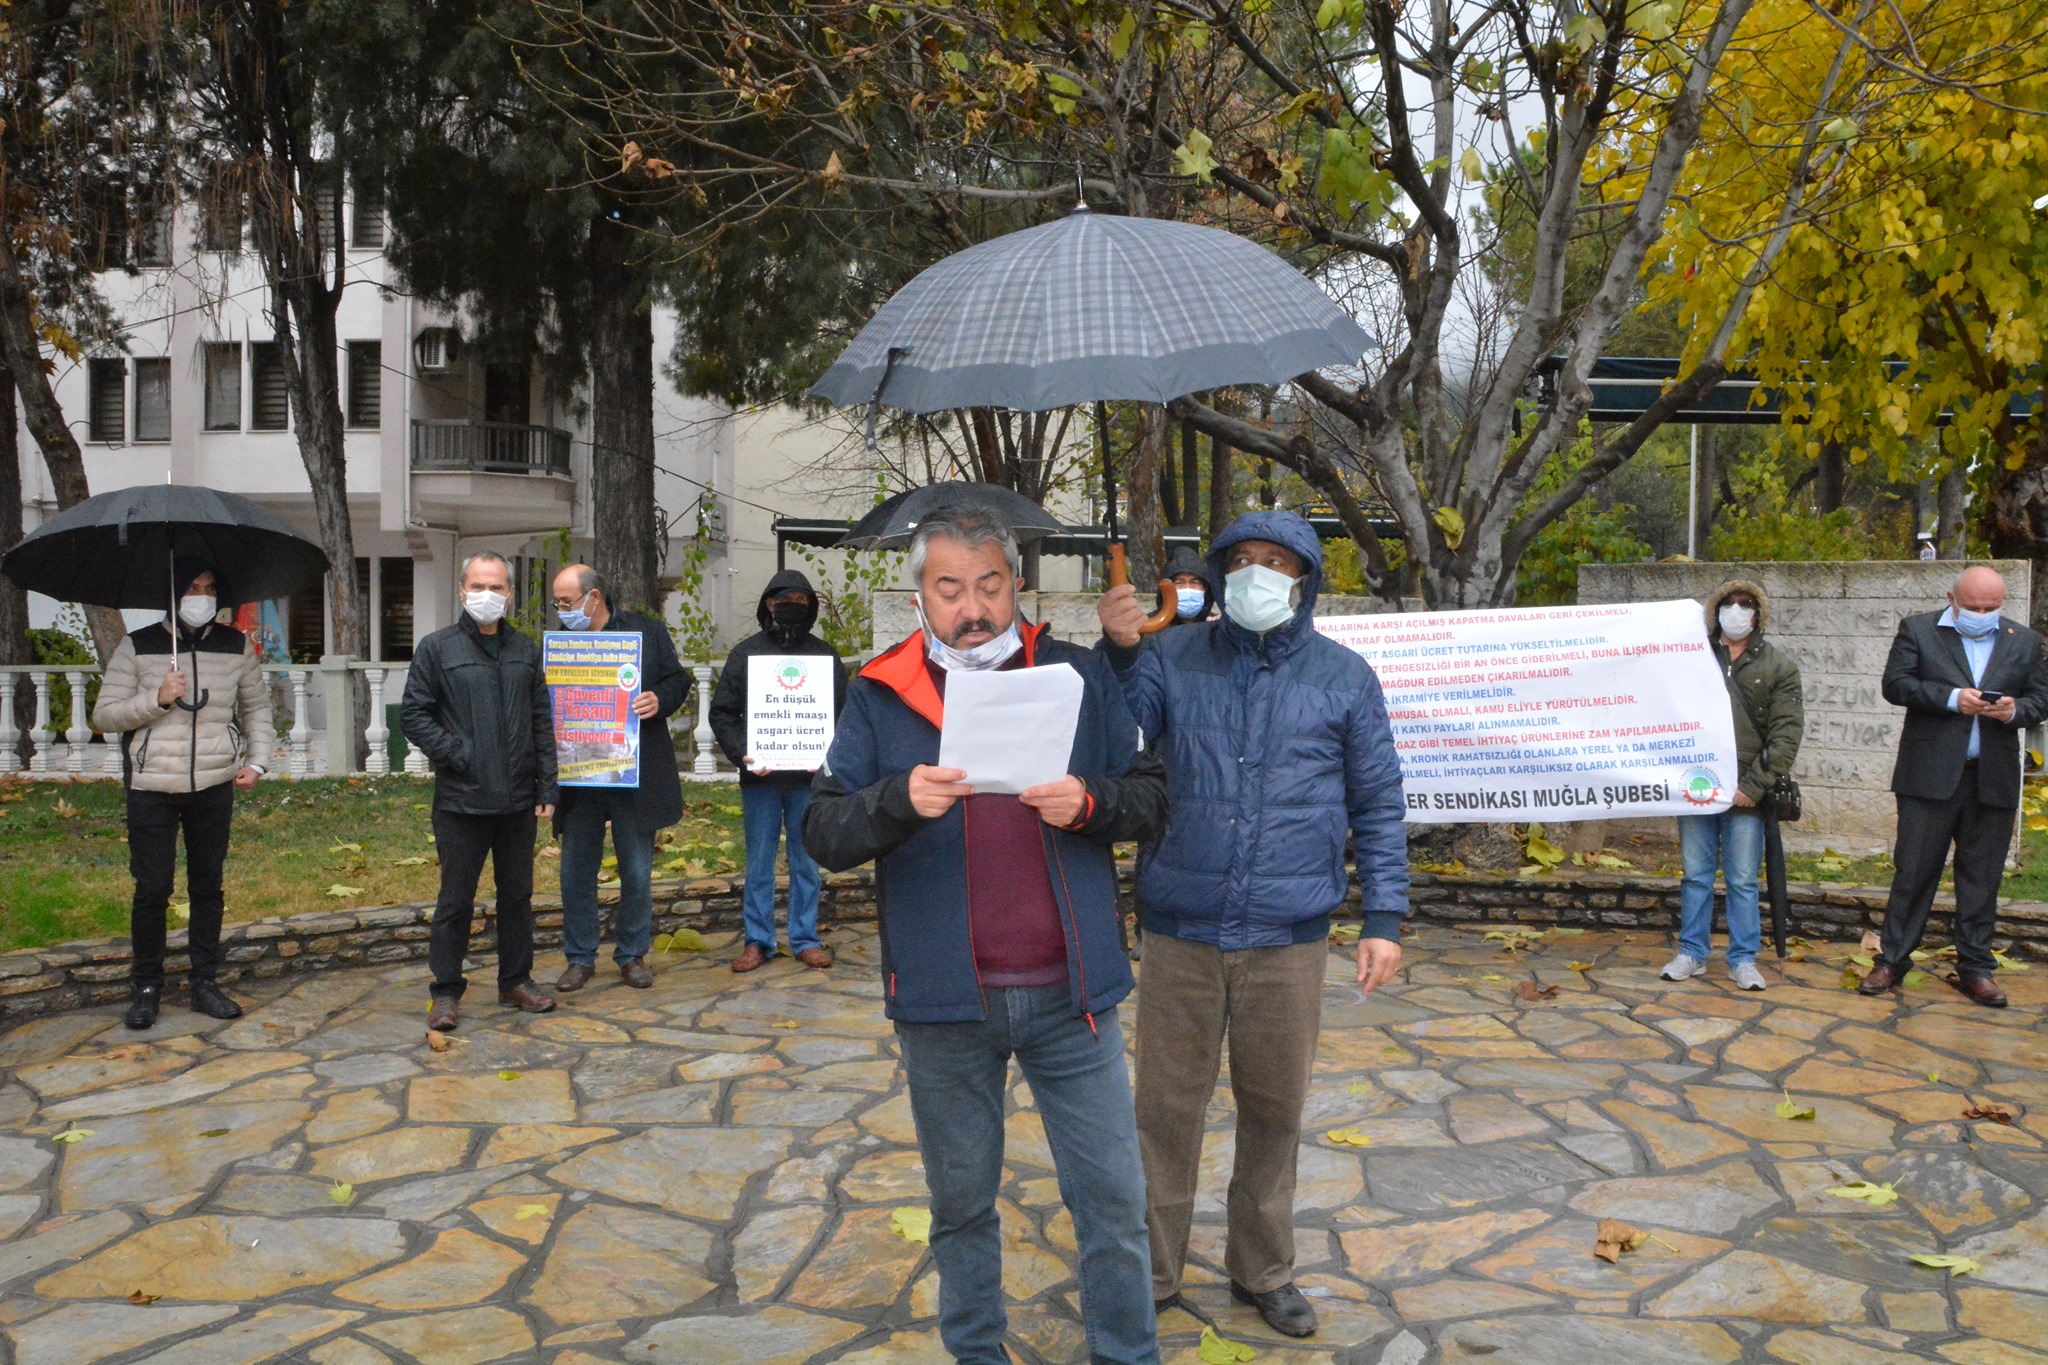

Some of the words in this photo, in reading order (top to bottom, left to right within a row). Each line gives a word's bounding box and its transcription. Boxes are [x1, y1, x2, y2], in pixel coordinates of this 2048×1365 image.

[1373, 621, 1402, 630] KARŞI
[1406, 618, 1446, 629] AÇILMIŞ
[1448, 616, 1495, 625] KAPATMA
[1498, 613, 1546, 623] DAVALARI
[1549, 611, 1572, 619] GERİ
[1575, 608, 1632, 619] ÇEKİLMELİ,
[1350, 636, 1381, 645] TARAF
[1384, 631, 1455, 644] OLMAMALIDIR.
[1381, 647, 1418, 659] ASGARİ
[1420, 646, 1454, 657] ÜCRET
[1456, 643, 1507, 654] TUTARINA
[1509, 636, 1609, 651] YÜKSELTİLMELİDİR.
[1382, 661, 1451, 674] DENGESİZLİĞİ
[1454, 659, 1471, 669] BİR
[1474, 659, 1488, 667] AN
[1491, 657, 1518, 666] ÖNCE
[1591, 648, 1620, 659] BUNA
[1622, 643, 1660, 658] İLİŞKİN
[1663, 642, 1705, 653] İNTİBAK
[1380, 678, 1425, 689] MAĞDUR
[1427, 674, 1485, 686] EDİLMEDEN
[565, 687, 613, 702] Güvenli
[765, 694, 779, 704] En
[783, 694, 816, 705] düşük
[1391, 691, 1440, 705] İKRAMİYE
[1443, 686, 1516, 701] VERİLMELİDİR.
[565, 702, 613, 721] Yaşam
[754, 710, 791, 719] emekli
[795, 712, 827, 721] maaşı
[1432, 707, 1472, 718] OLMALI,
[1475, 704, 1504, 714] KAMU
[1507, 701, 1542, 712] ELİYLE
[1545, 695, 1637, 710] YÜRÜTÜLMELİDİR.
[756, 726, 793, 736] asgari
[796, 726, 825, 735] ücret
[1401, 724, 1431, 734] KATKI
[1433, 722, 1475, 733] PAYLARI
[1478, 716, 1560, 730] ALINMAMALIDIR.
[1394, 739, 1416, 749] GAZ
[1419, 738, 1439, 748] GİBİ
[1442, 738, 1475, 746] TEMEL
[1477, 734, 1518, 746] İHTİYAÇ
[1521, 730, 1585, 742] ÜRÜNLERİNE
[1589, 729, 1610, 738] ZAM
[1613, 721, 1703, 737] YAPILMAMALIDIR.
[755, 741, 788, 750] kadar
[792, 741, 826, 750] olsun!
[1411, 753, 1449, 764] KRONİK
[1452, 748, 1522, 762] RAHATSIZLIĞI
[1523, 747, 1578, 758] OLANLARA
[1581, 745, 1613, 754] YEREL
[1617, 744, 1629, 752] YA
[1632, 743, 1646, 752] DA
[1649, 736, 1695, 751] MERKEZİ
[1444, 766, 1506, 777] İHTİYAÇLARI
[1509, 763, 1573, 775] KARŞILIKSIZ
[1575, 760, 1617, 770] OLARAK
[1621, 753, 1718, 768] KARŞILANMALIDIR.
[1405, 793, 1429, 811] ER
[1433, 788, 1527, 809] SENDİKASI
[1533, 784, 1598, 806] MUĞLA
[1603, 779, 1670, 809] ŞUBESİ
